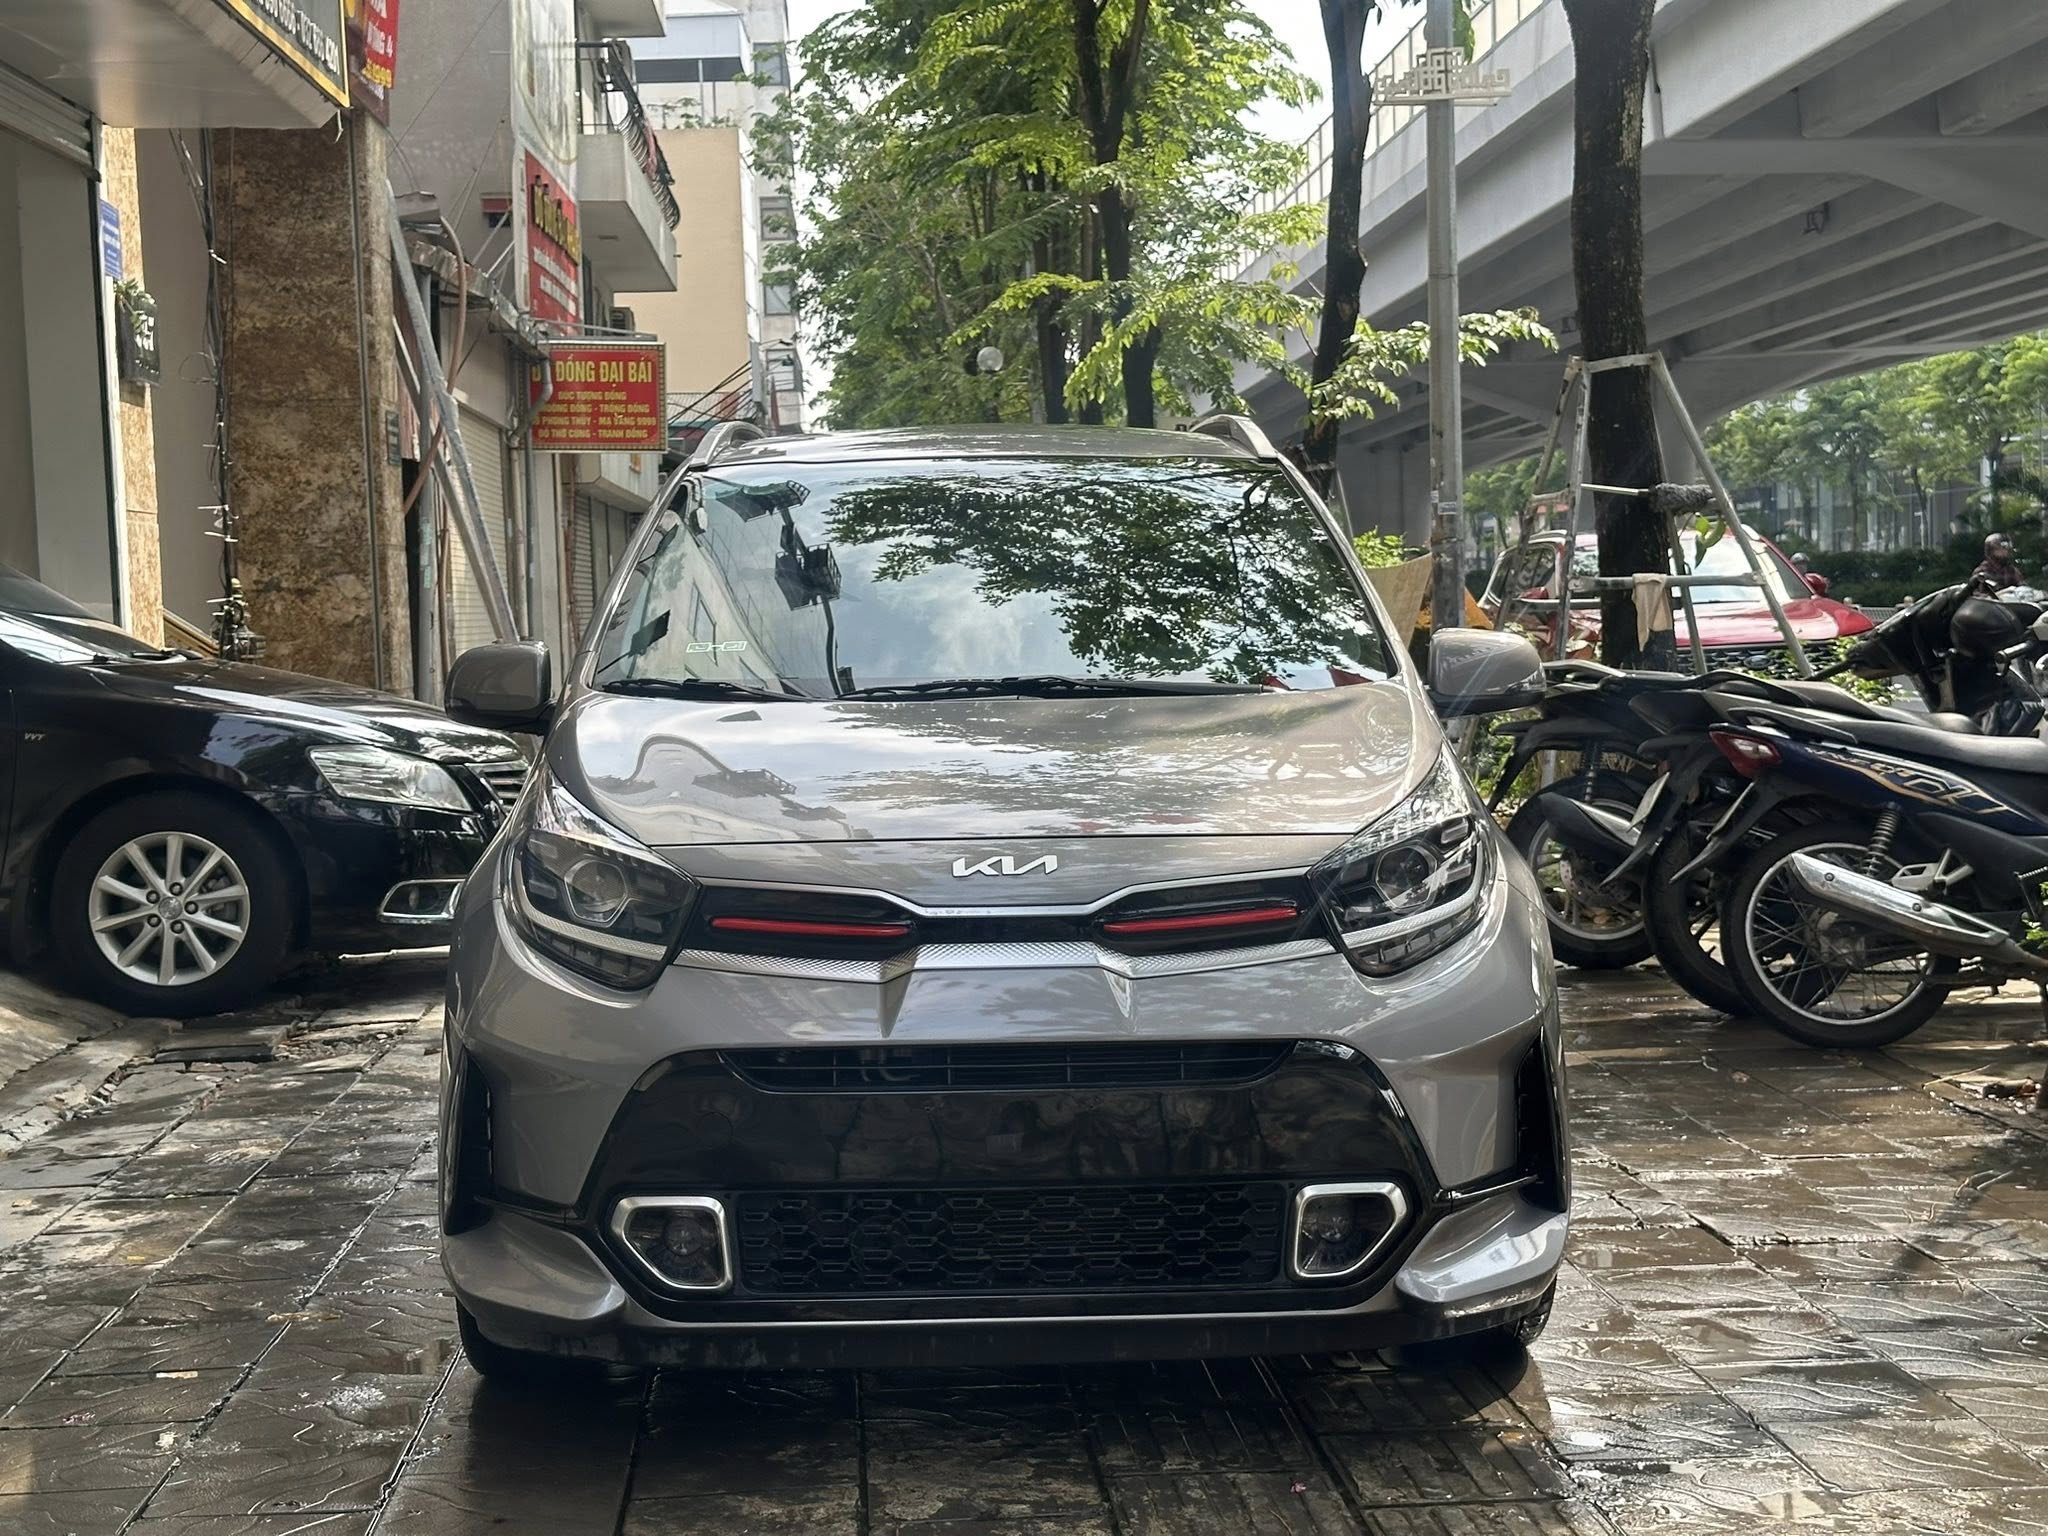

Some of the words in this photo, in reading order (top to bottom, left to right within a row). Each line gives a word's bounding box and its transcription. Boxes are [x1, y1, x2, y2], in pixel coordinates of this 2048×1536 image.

[599, 361, 624, 387] ĐẠI
[628, 355, 652, 383] BÁI
[952, 855, 1058, 877] KIA
